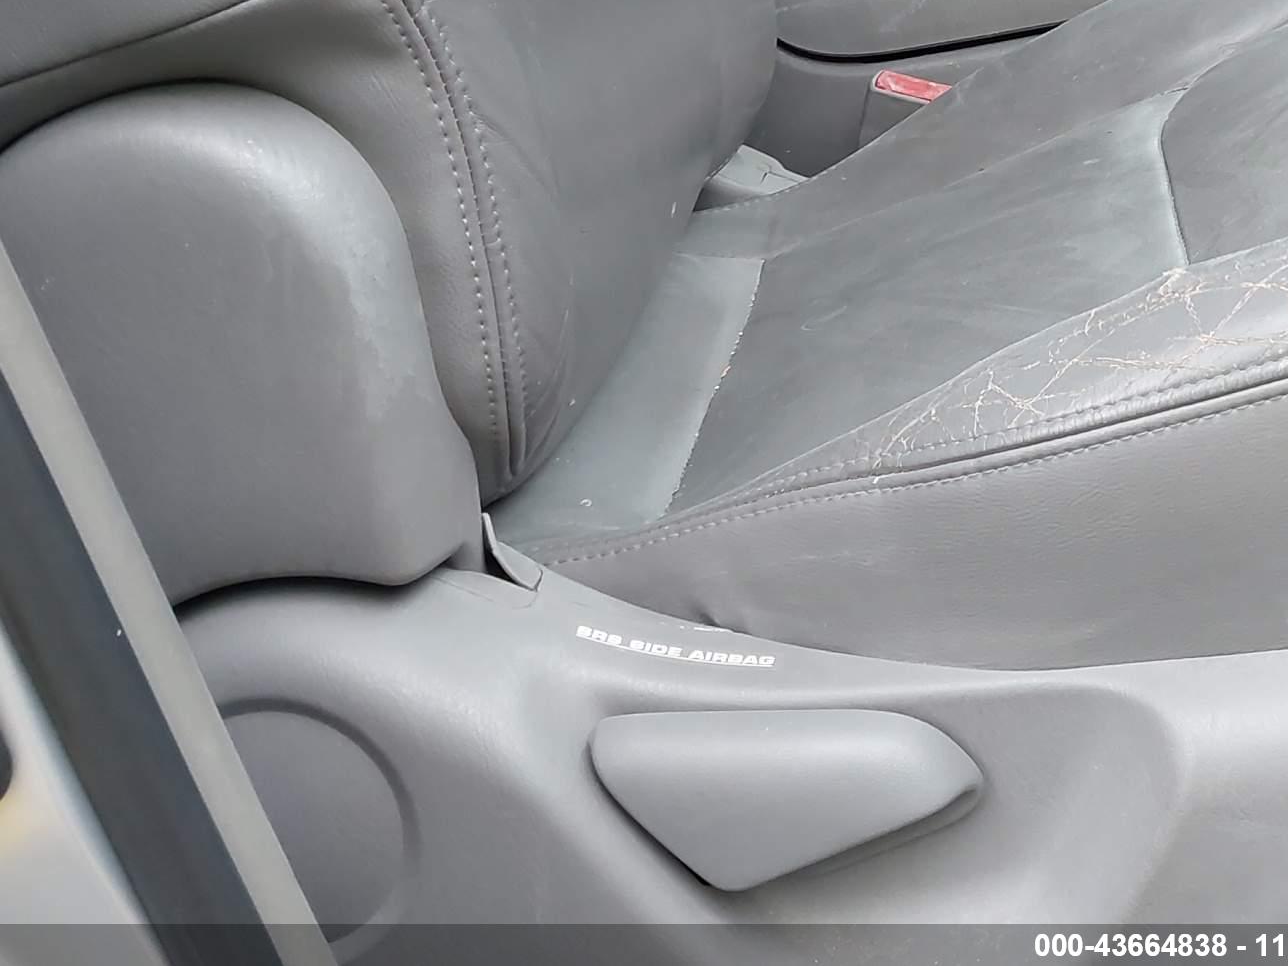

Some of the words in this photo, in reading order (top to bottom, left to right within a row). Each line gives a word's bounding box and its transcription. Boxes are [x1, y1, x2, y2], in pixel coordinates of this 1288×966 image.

[576, 625, 622, 645] SRS
[629, 639, 683, 657] SIDE
[688, 649, 776, 666] AIRBAG
